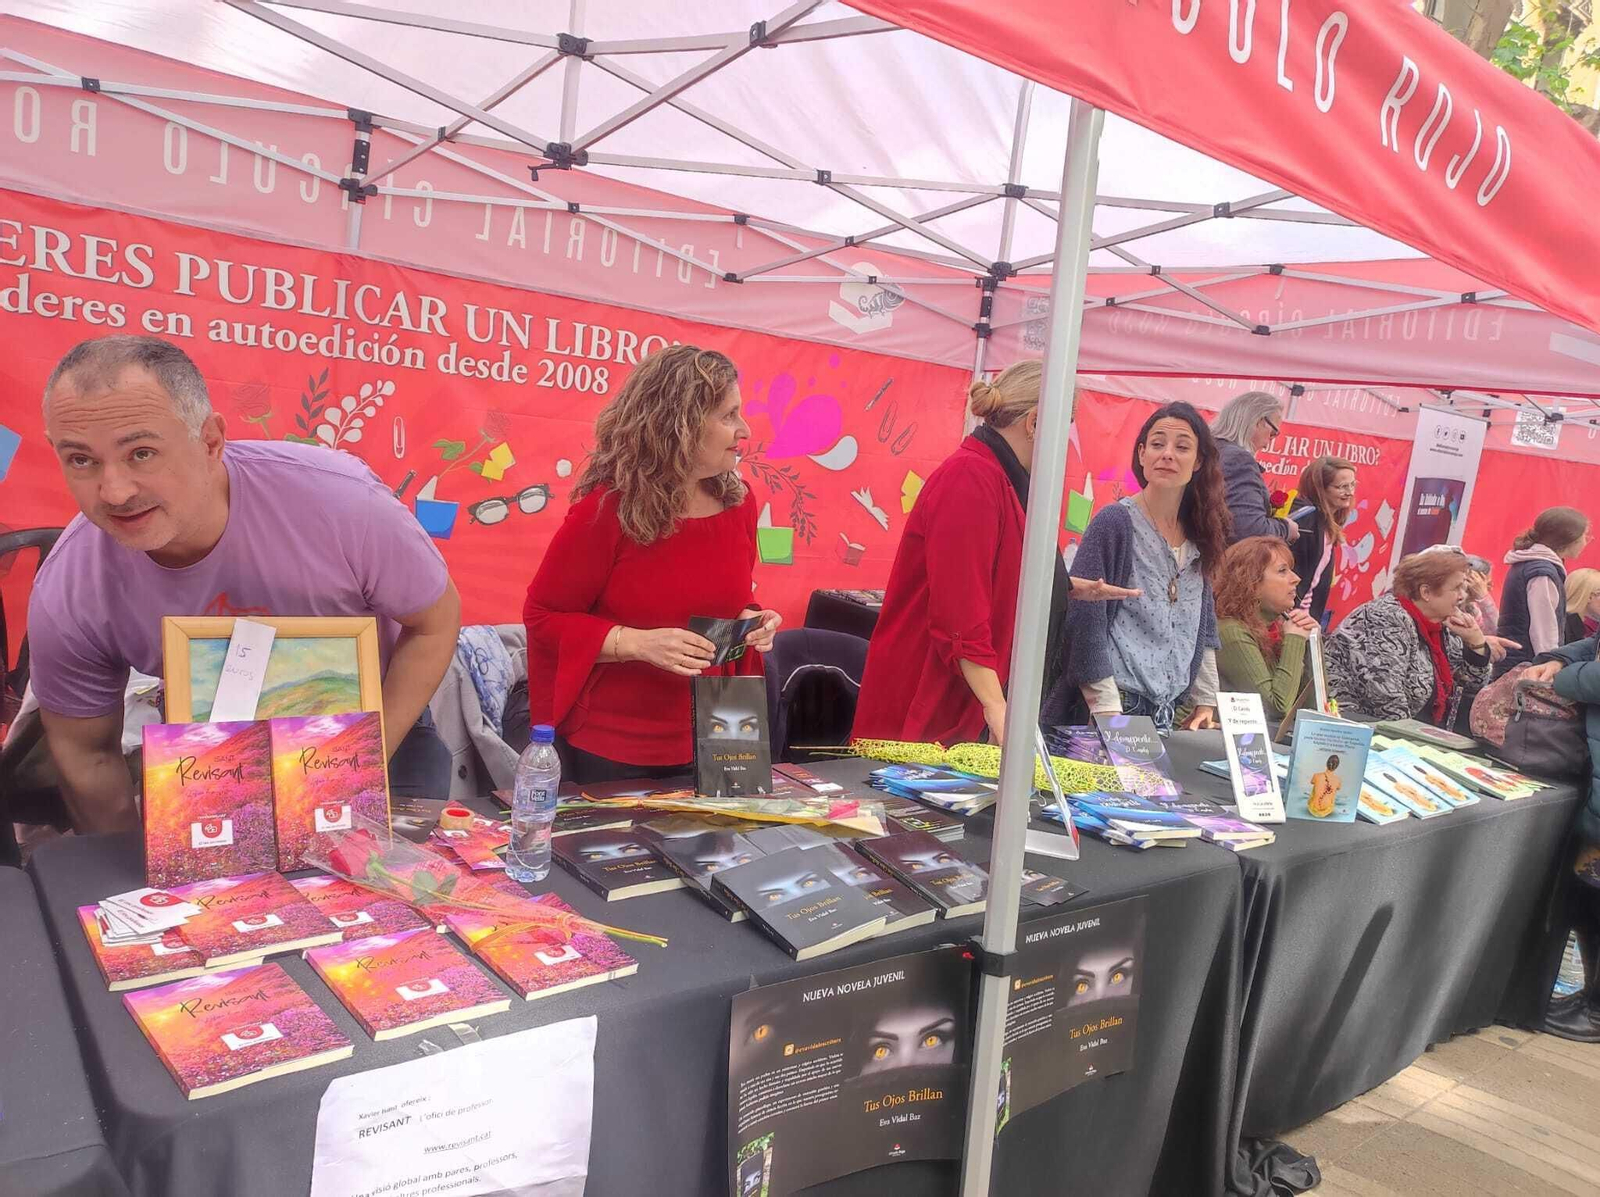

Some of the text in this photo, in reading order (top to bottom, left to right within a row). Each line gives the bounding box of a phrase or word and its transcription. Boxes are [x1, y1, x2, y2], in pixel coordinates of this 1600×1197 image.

[1380, 55, 1511, 206] ROJO
[173, 252, 450, 336] PUBLICAR
[463, 303, 533, 351] UN
[545, 318, 684, 366] LIBRO
[141, 308, 194, 338] en
[208, 318, 427, 370] autoedición
[437, 342, 528, 384] desde
[536, 358, 610, 395] 2008
[1313, 438, 1334, 459] UN
[1333, 440, 1380, 466] LIBRO?
[235, 643, 252, 658] 15
[176, 755, 245, 787] Revisant
[300, 746, 361, 775] Revisant
[197, 889, 275, 910] Revisant
[819, 895, 842, 908] Brillan
[1025, 917, 1101, 944] NUEVA NOVELA JUVENIL
[356, 950, 434, 972] Revisant
[803, 970, 906, 1003] NUEVA NOVELA JUVENIL
[180, 989, 271, 1018] Revisant
[1069, 1015, 1123, 1040] Tus Ojos Brillan
[864, 1087, 944, 1113] Tus Ojos Brillan
[358, 1110, 380, 1120] Xavier
[358, 1115, 412, 1139] REVISANT
[445, 1107, 456, 1117] de
[879, 1118, 891, 1127] Eva
[891, 1113, 908, 1124] Vidal
[423, 1131, 491, 1154] www.revisant.cat
[392, 1175, 421, 1191] global
[422, 1171, 443, 1182] amb
[445, 1165, 472, 1179] pares,
[473, 1151, 518, 1172] professors,
[421, 1176, 482, 1196] professionals.
